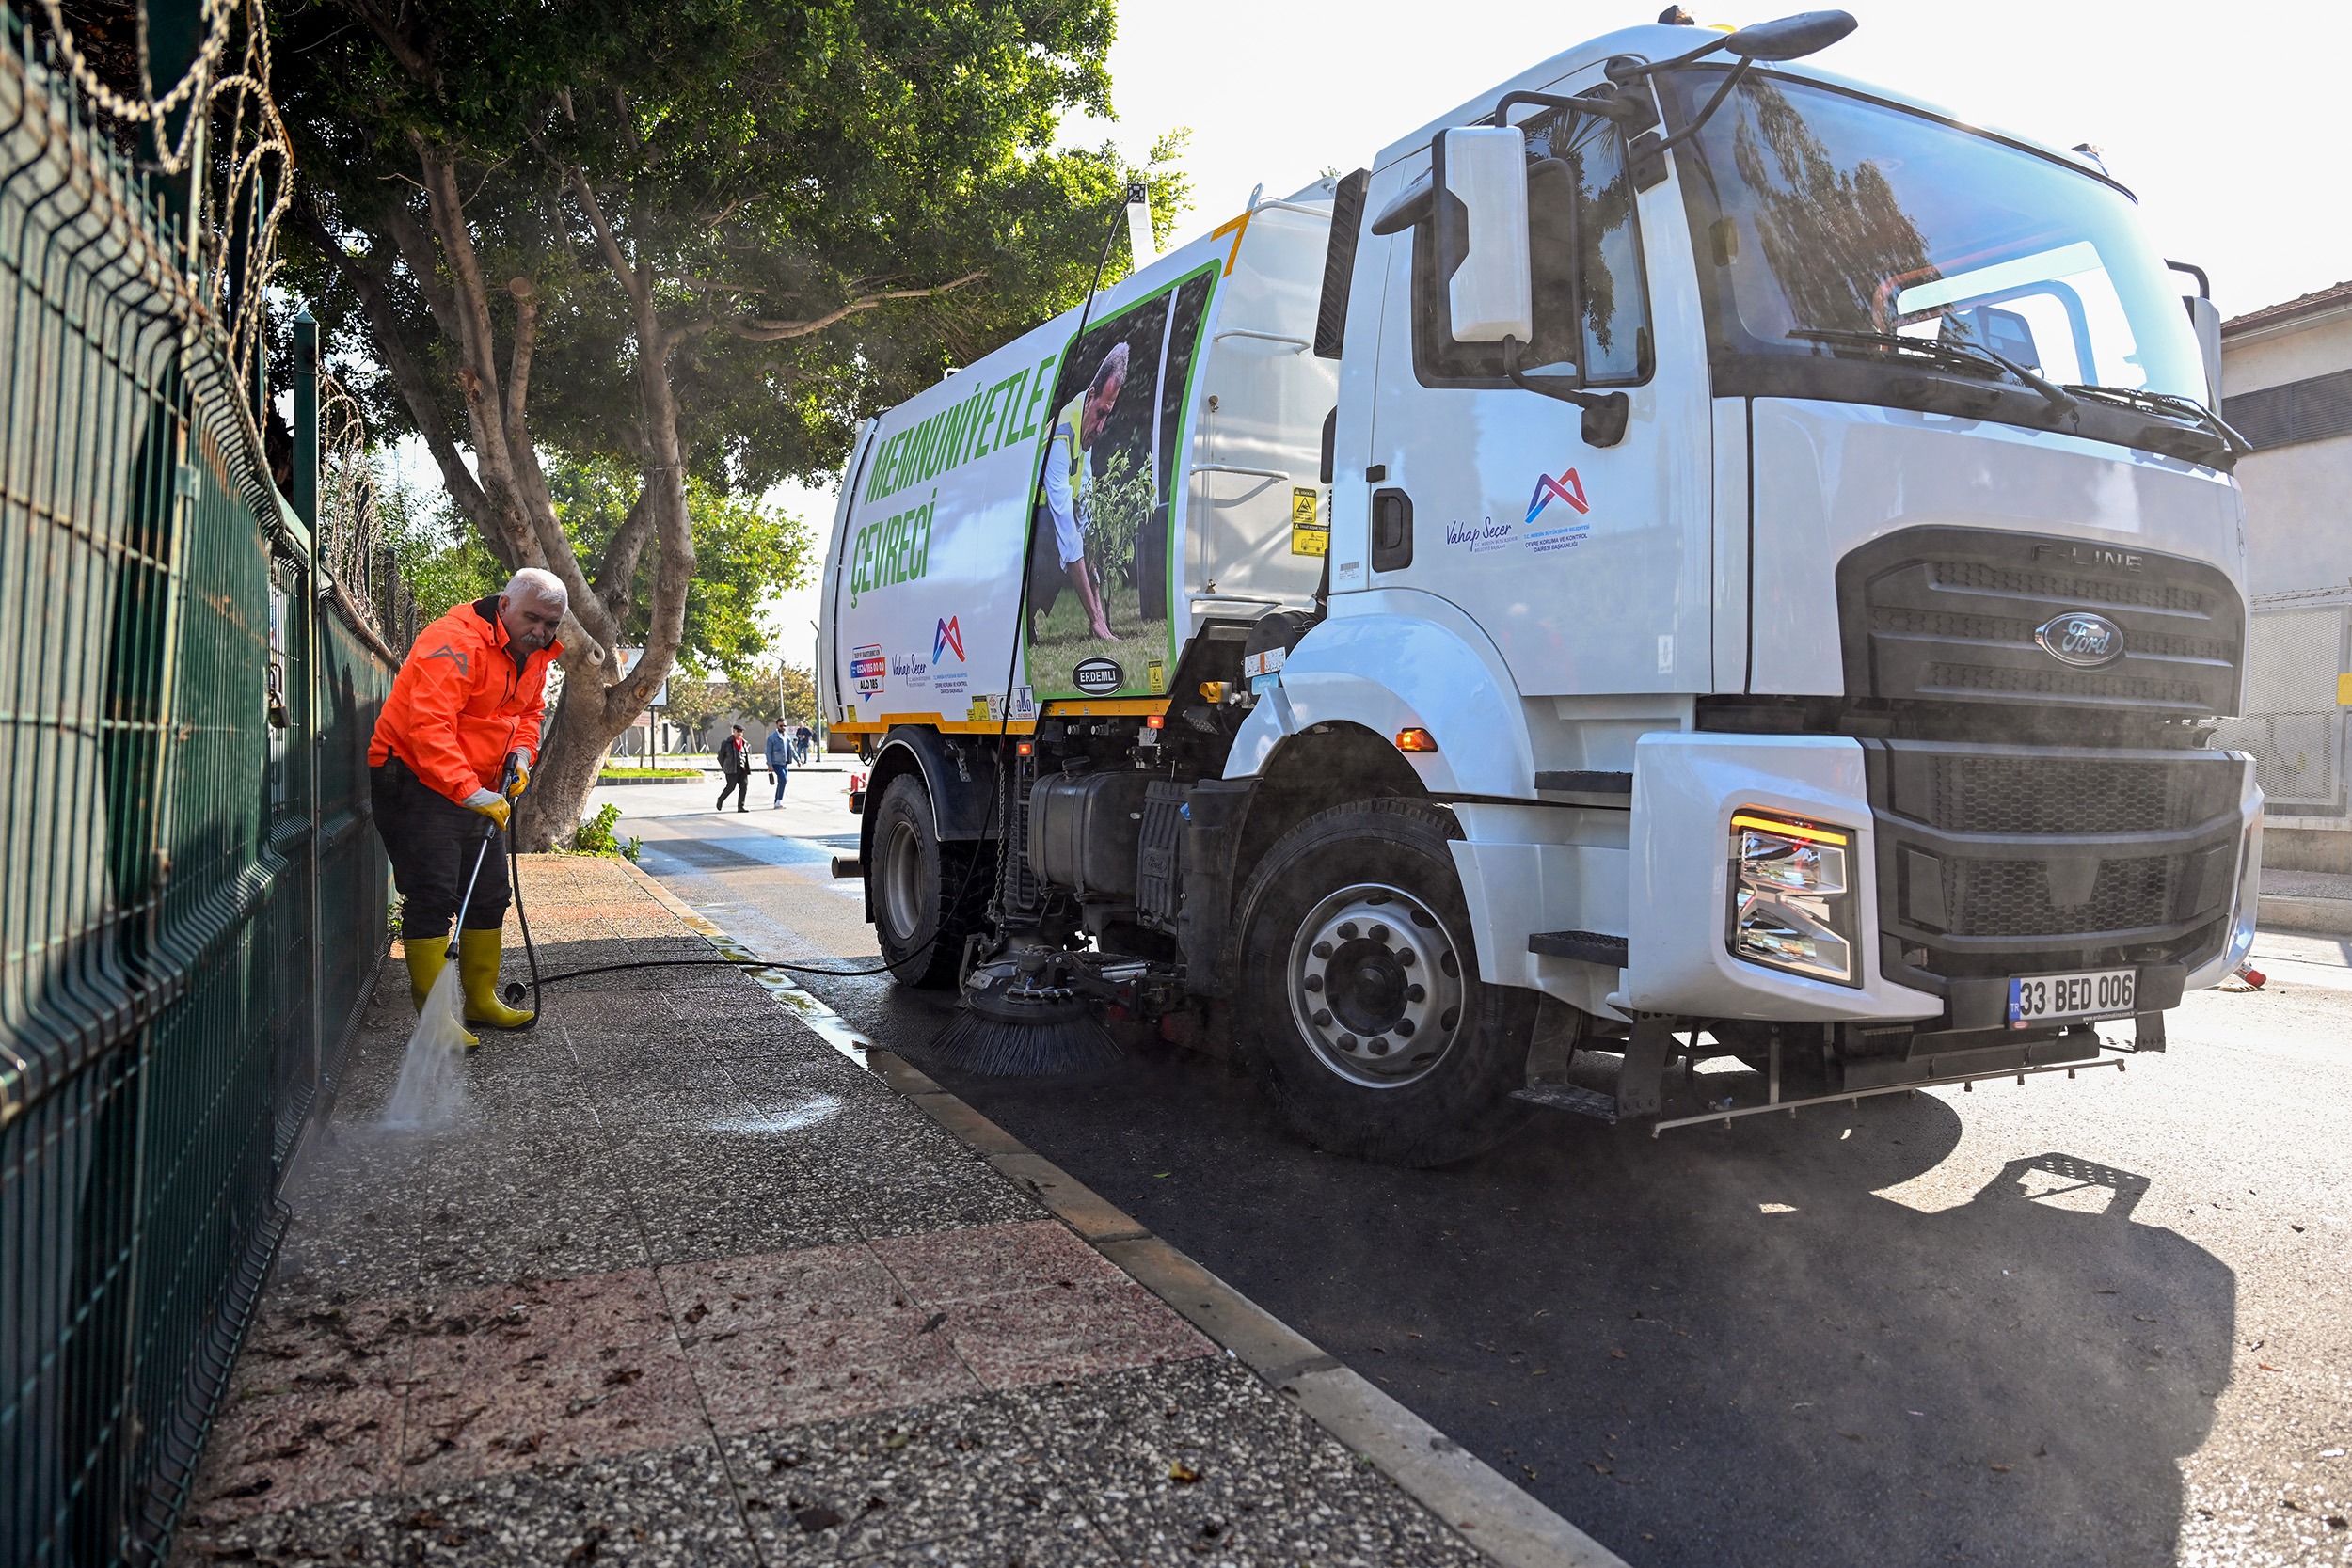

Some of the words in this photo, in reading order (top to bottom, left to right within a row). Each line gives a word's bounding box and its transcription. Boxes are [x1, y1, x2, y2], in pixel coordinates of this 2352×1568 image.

[864, 354, 1057, 505] MEMNUNİYETLE
[850, 488, 938, 609] ÇEVRECİ
[1446, 520, 1480, 552] Vahap
[1482, 516, 1512, 539] Seçer
[1539, 537, 1559, 546] KORUMA
[2032, 543, 2143, 572] F-LINE
[2062, 620, 2110, 656] Ford
[860, 679, 869, 689] ALO
[2010, 1003, 2020, 1012] TR
[2020, 981, 2046, 1016] 33
[2055, 977, 2092, 1013] BED
[2098, 974, 2133, 1008] 006
